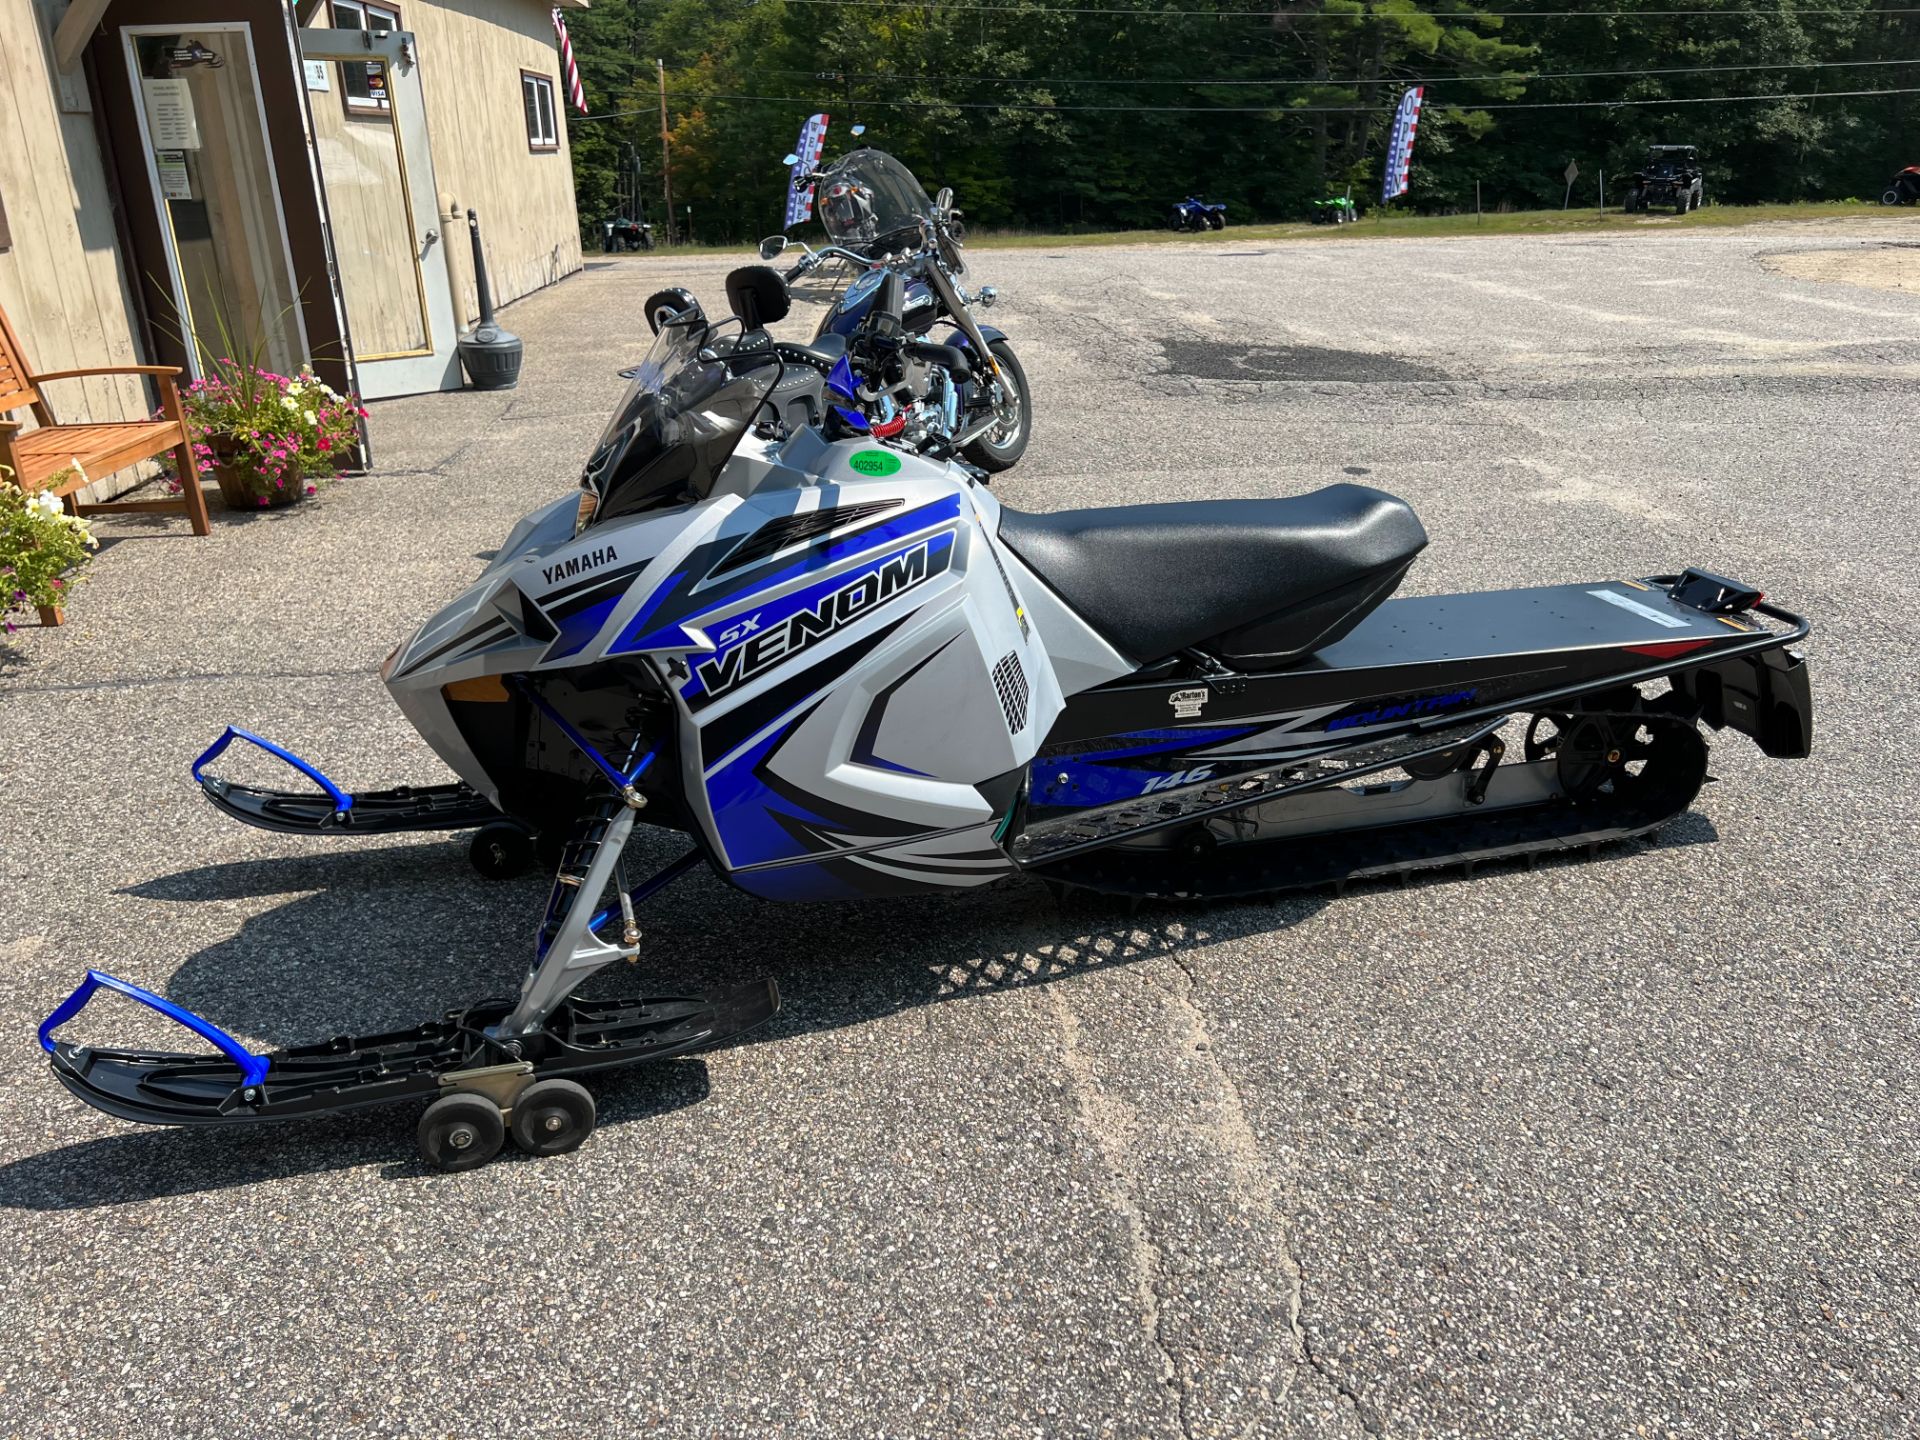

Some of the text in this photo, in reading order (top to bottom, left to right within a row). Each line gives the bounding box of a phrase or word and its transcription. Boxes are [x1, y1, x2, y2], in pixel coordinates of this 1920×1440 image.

[1391, 95, 1414, 194] OPEN
[542, 545, 618, 585] YAMAHA
[695, 541, 929, 697] VENOM
[719, 612, 762, 646] SX
[1326, 688, 1477, 732] MOUNTAIN
[1140, 762, 1217, 795] 146
